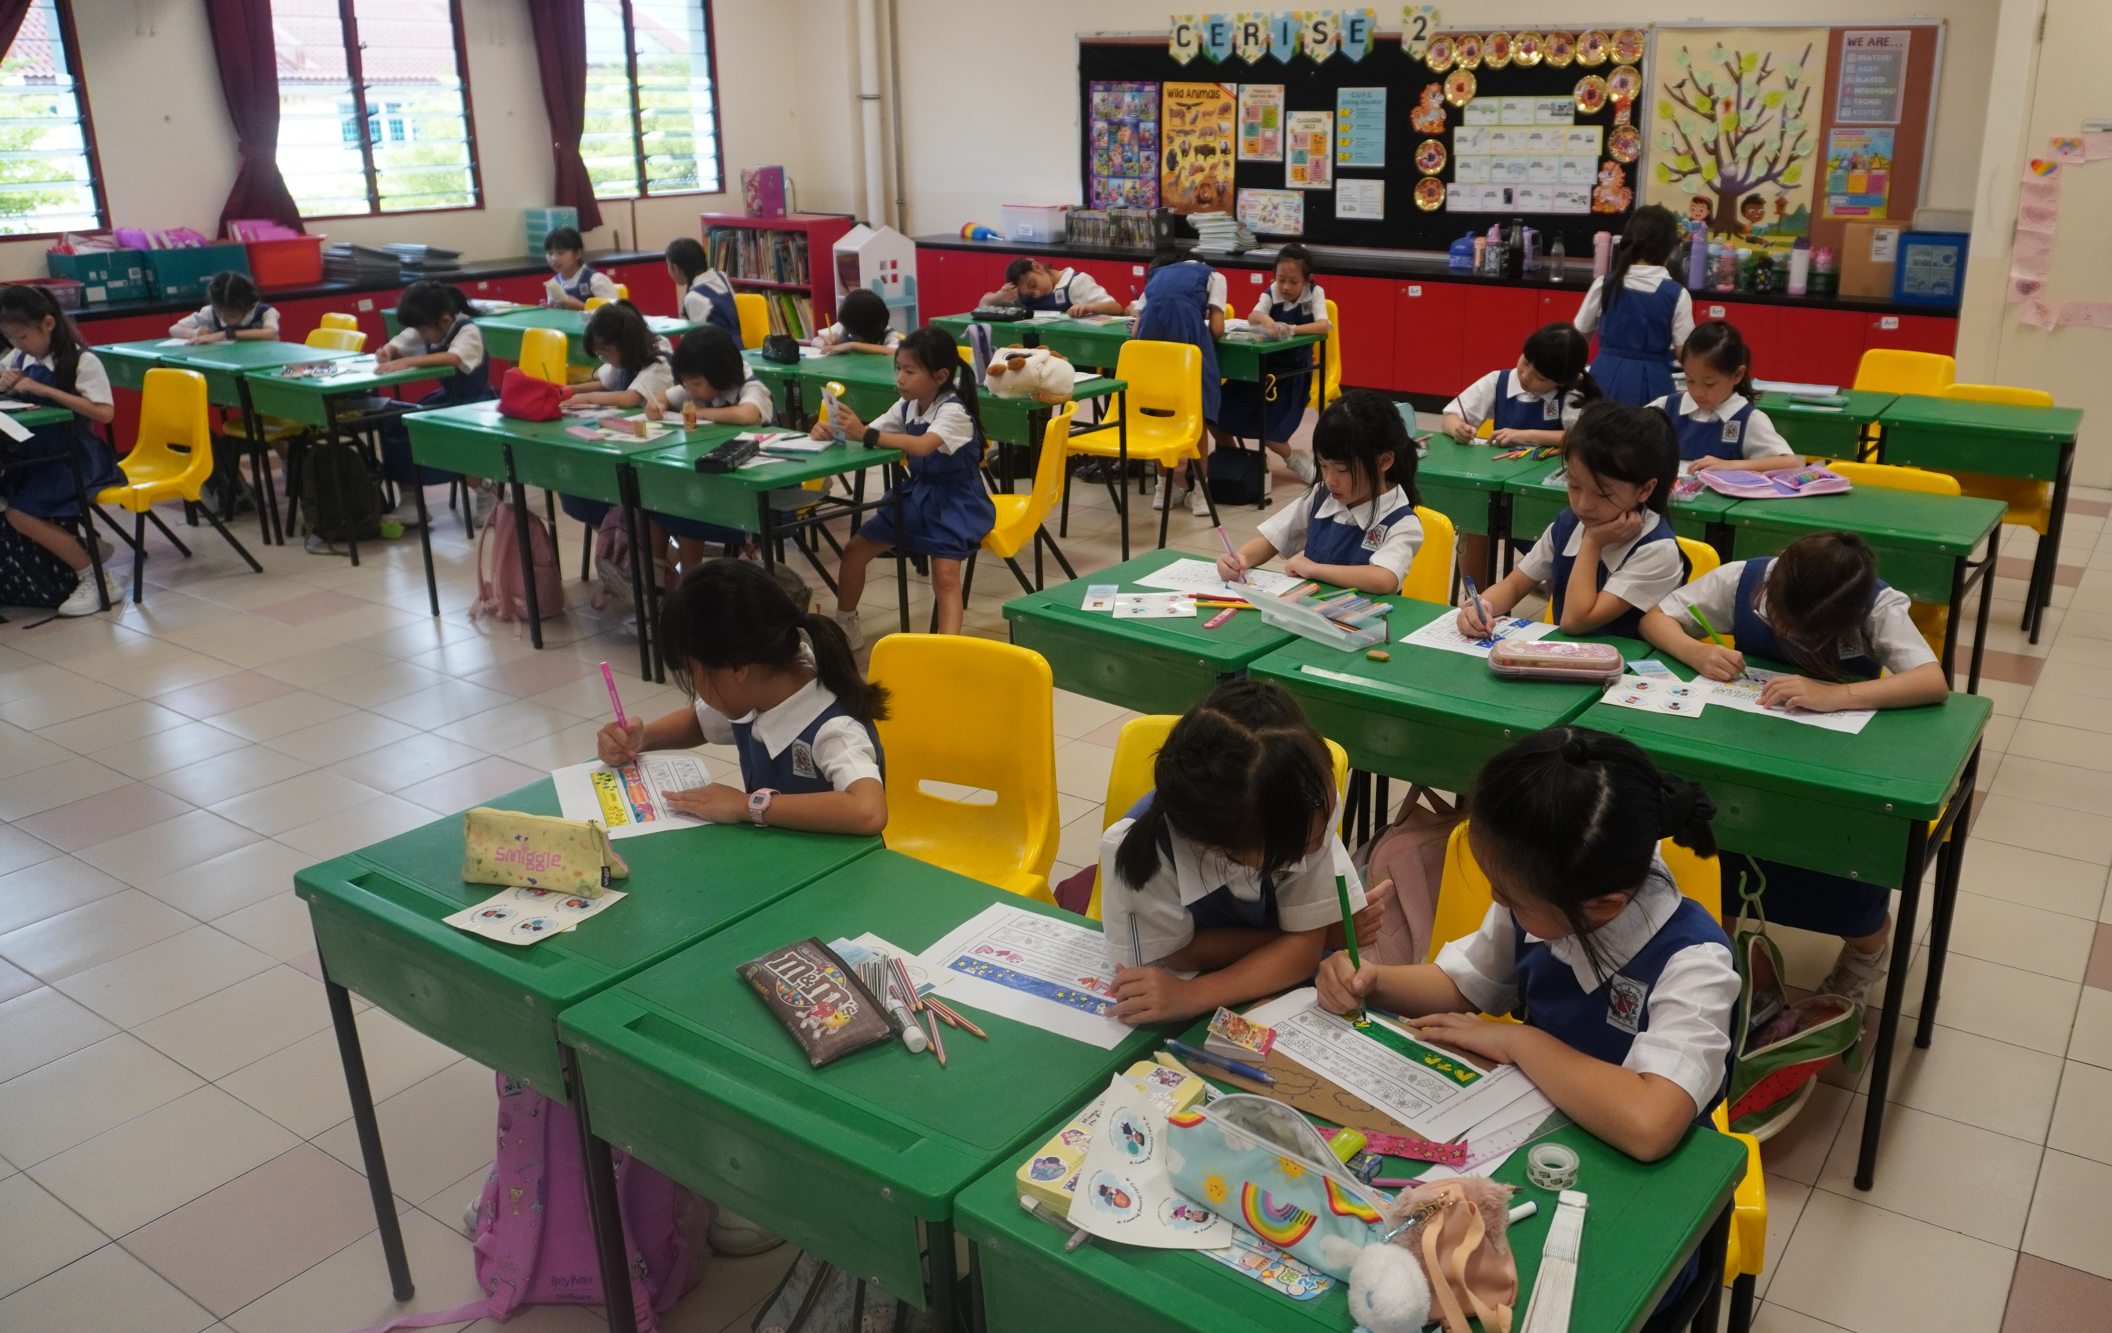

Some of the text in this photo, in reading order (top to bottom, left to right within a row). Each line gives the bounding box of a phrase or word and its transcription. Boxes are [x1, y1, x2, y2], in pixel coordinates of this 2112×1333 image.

[1176, 15, 1427, 48] CERISE 2
[1847, 37, 1902, 47] WE ARE...
[1167, 88, 1221, 99] Wild Animals
[494, 843, 562, 873] smiggle
